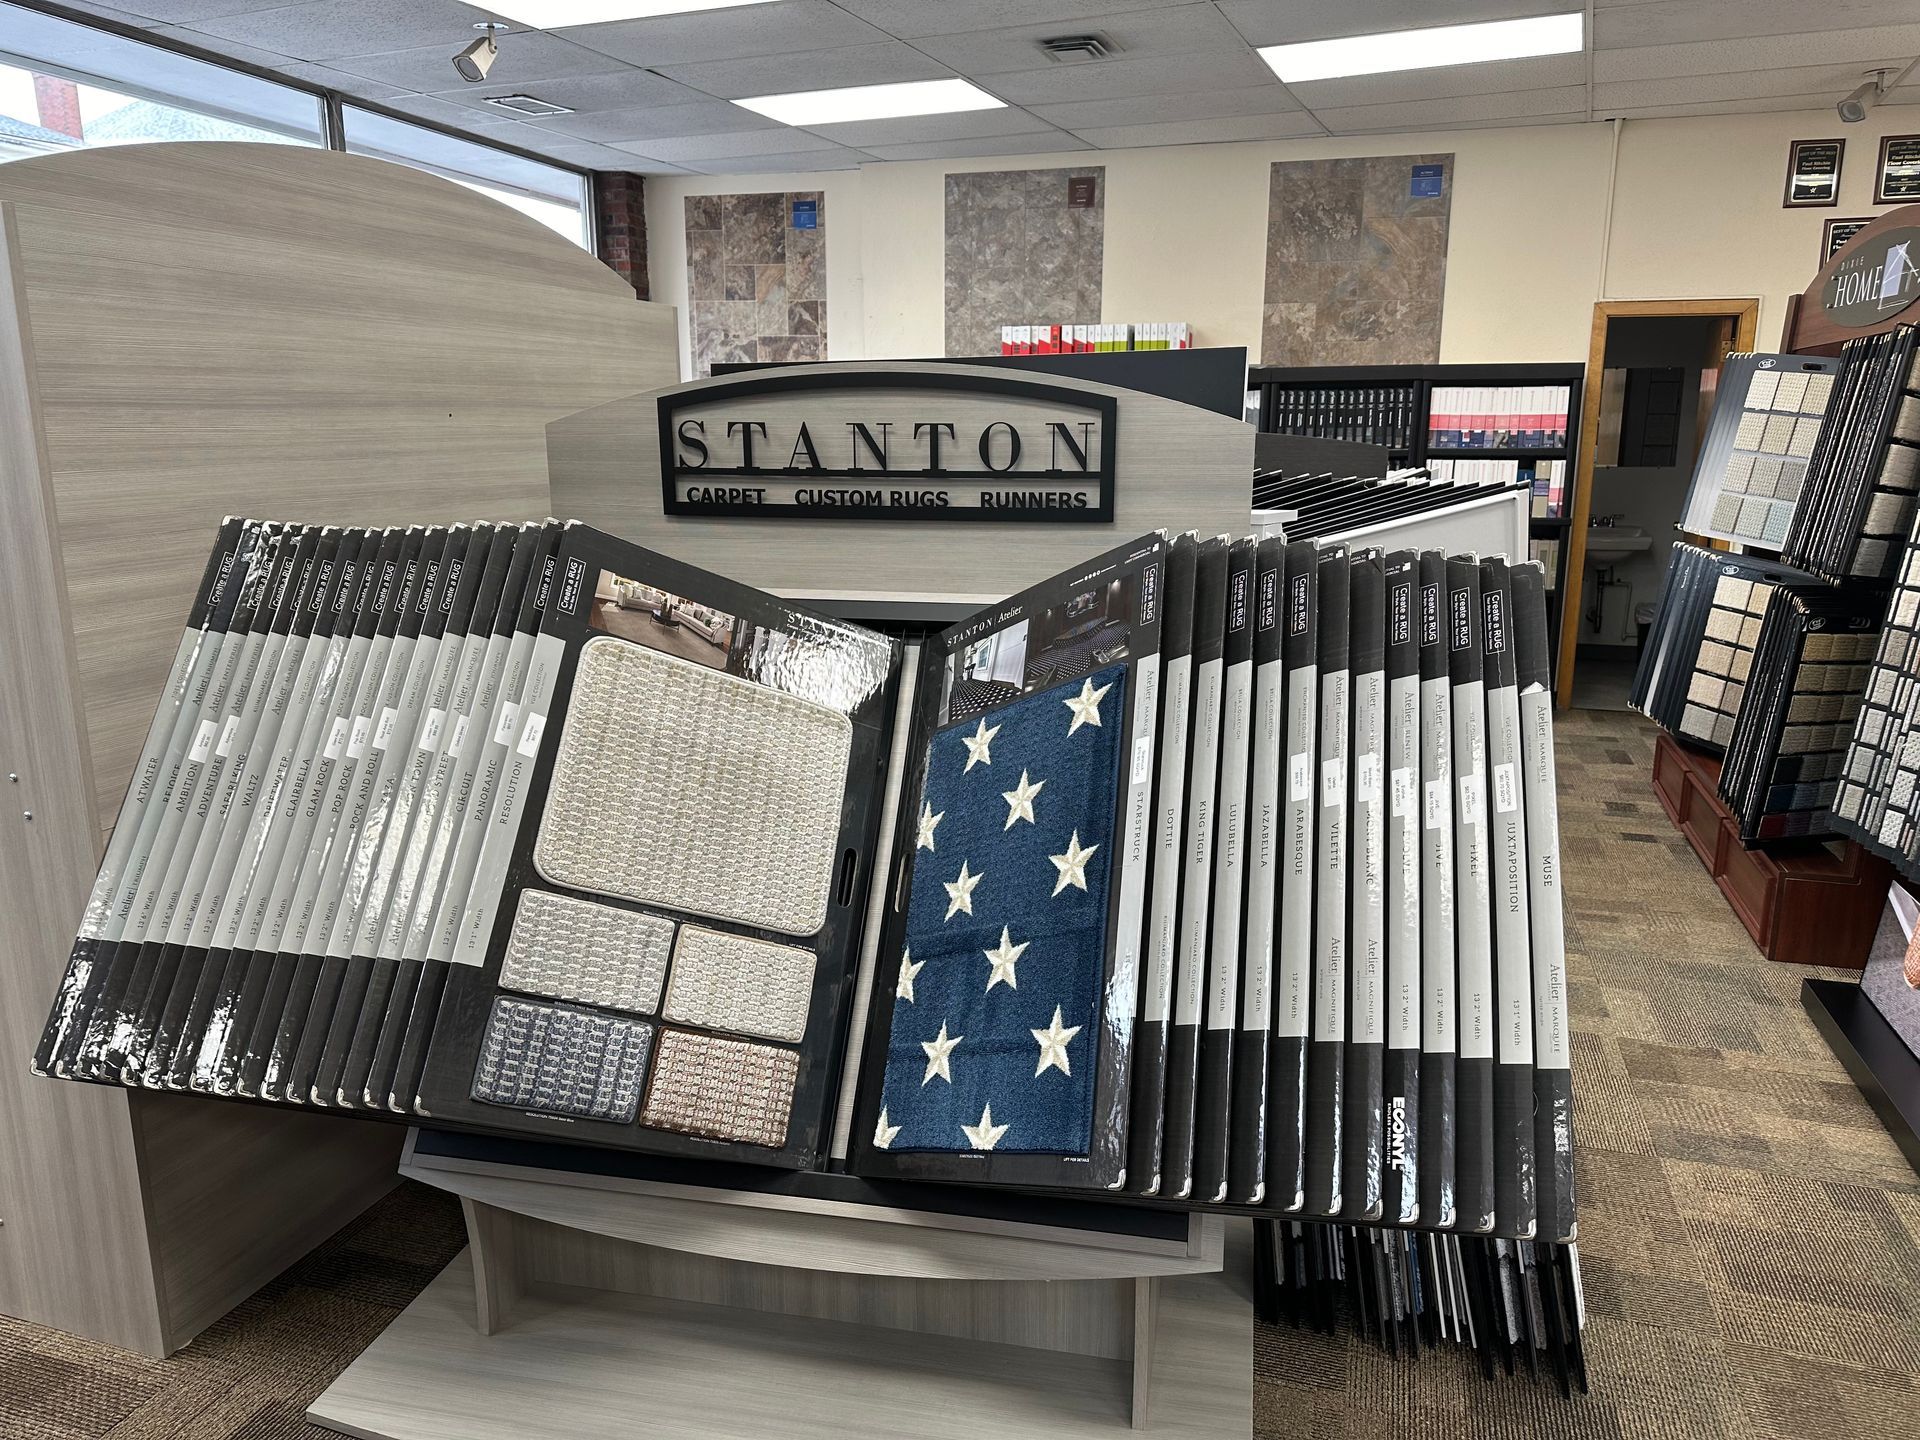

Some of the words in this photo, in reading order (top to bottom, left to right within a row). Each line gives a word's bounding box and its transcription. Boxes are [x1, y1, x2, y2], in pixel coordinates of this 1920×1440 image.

[1834, 266, 1883, 308] HOME
[676, 419, 1096, 473] STANTON
[686, 485, 767, 506] CARPET
[794, 488, 883, 508] CUSTOM
[889, 490, 950, 509] RUGS
[980, 491, 1088, 510] RUNNERS
[212, 579, 226, 602] Create
[223, 556, 233, 573] RUG
[312, 586, 325, 609] Create
[321, 564, 332, 580] RUG
[375, 587, 388, 610] Create
[384, 565, 395, 581] RUG
[419, 587, 432, 610] Create
[428, 565, 438, 581] RUG
[442, 586, 454, 610] Create
[451, 563, 461, 580] RUG
[537, 583, 549, 607] Create
[545, 560, 555, 577] RUG
[561, 584, 572, 608] Create
[568, 561, 578, 578] RUG
[1148, 568, 1156, 593] Create
[1237, 575, 1245, 600] Create
[1266, 573, 1274, 599] Create
[1146, 600, 1154, 619] RUG
[1265, 606, 1273, 625] RUG
[1400, 587, 1408, 613] Create
[1459, 592, 1467, 618] Create
[1492, 594, 1500, 621] Create
[947, 618, 993, 647] STANTON
[998, 605, 1024, 623] Atelier
[1236, 607, 1244, 627] RUG
[1298, 611, 1306, 630] RUG
[1399, 621, 1408, 640] RUG
[1428, 621, 1437, 641] RUG
[1460, 626, 1469, 645] RUG
[1493, 629, 1502, 649] RUG
[192, 675, 208, 707] Atelier
[208, 684, 226, 713] Atelier
[272, 684, 289, 715] Atelier
[452, 684, 468, 714] Atelier
[479, 681, 492, 710] Atelier
[1145, 670, 1154, 701] Atelier
[1335, 676, 1345, 706] Atelier
[1405, 692, 1415, 725] Atelier
[1435, 694, 1445, 726] Atelier
[1537, 705, 1548, 737] Atelier
[231, 753, 247, 780] KING
[365, 751, 379, 776] ROLL
[412, 751, 427, 781] TOWN
[434, 750, 449, 787] STREET
[136, 757, 159, 804] ATWATER
[176, 763, 198, 813] AMBITION
[197, 758, 223, 818] ADVENTURE
[241, 774, 259, 807] WALTZ
[286, 758, 311, 818] CLAIRBELLA
[306, 788, 321, 818] GLAM
[316, 760, 330, 787] ROCK
[331, 793, 344, 813] POP
[341, 765, 353, 792] ROCK
[360, 779, 371, 800] AND
[455, 772, 473, 813] CIRCUIT
[474, 759, 498, 822] PANORAMIC
[500, 760, 523, 825] RESOLUTION
[349, 803, 364, 829] ROCK
[1132, 791, 1144, 862] STARSTRUCK
[1166, 808, 1174, 849] DOTTIE
[1199, 800, 1207, 828] KING
[1196, 831, 1204, 864] TIGER
[1227, 803, 1237, 868] LULUBELLA
[1260, 804, 1270, 868] JAZABELLA
[1295, 808, 1304, 875] ARABESQUE
[1330, 822, 1339, 870] VILETTE
[1506, 821, 1519, 913] JUXTAPOSITION
[1542, 855, 1553, 887] MUSE
[117, 887, 136, 920] Atelier
[144, 890, 155, 909] Width
[210, 894, 221, 917] Width
[325, 901, 335, 921] Width
[474, 908, 484, 929] Width
[1331, 937, 1342, 974] Atelier
[1368, 938, 1379, 975] Atelier
[1550, 964, 1562, 1001] Atelier
[1219, 988, 1227, 1012] Width
[1552, 1006, 1560, 1053] MARQUEE
